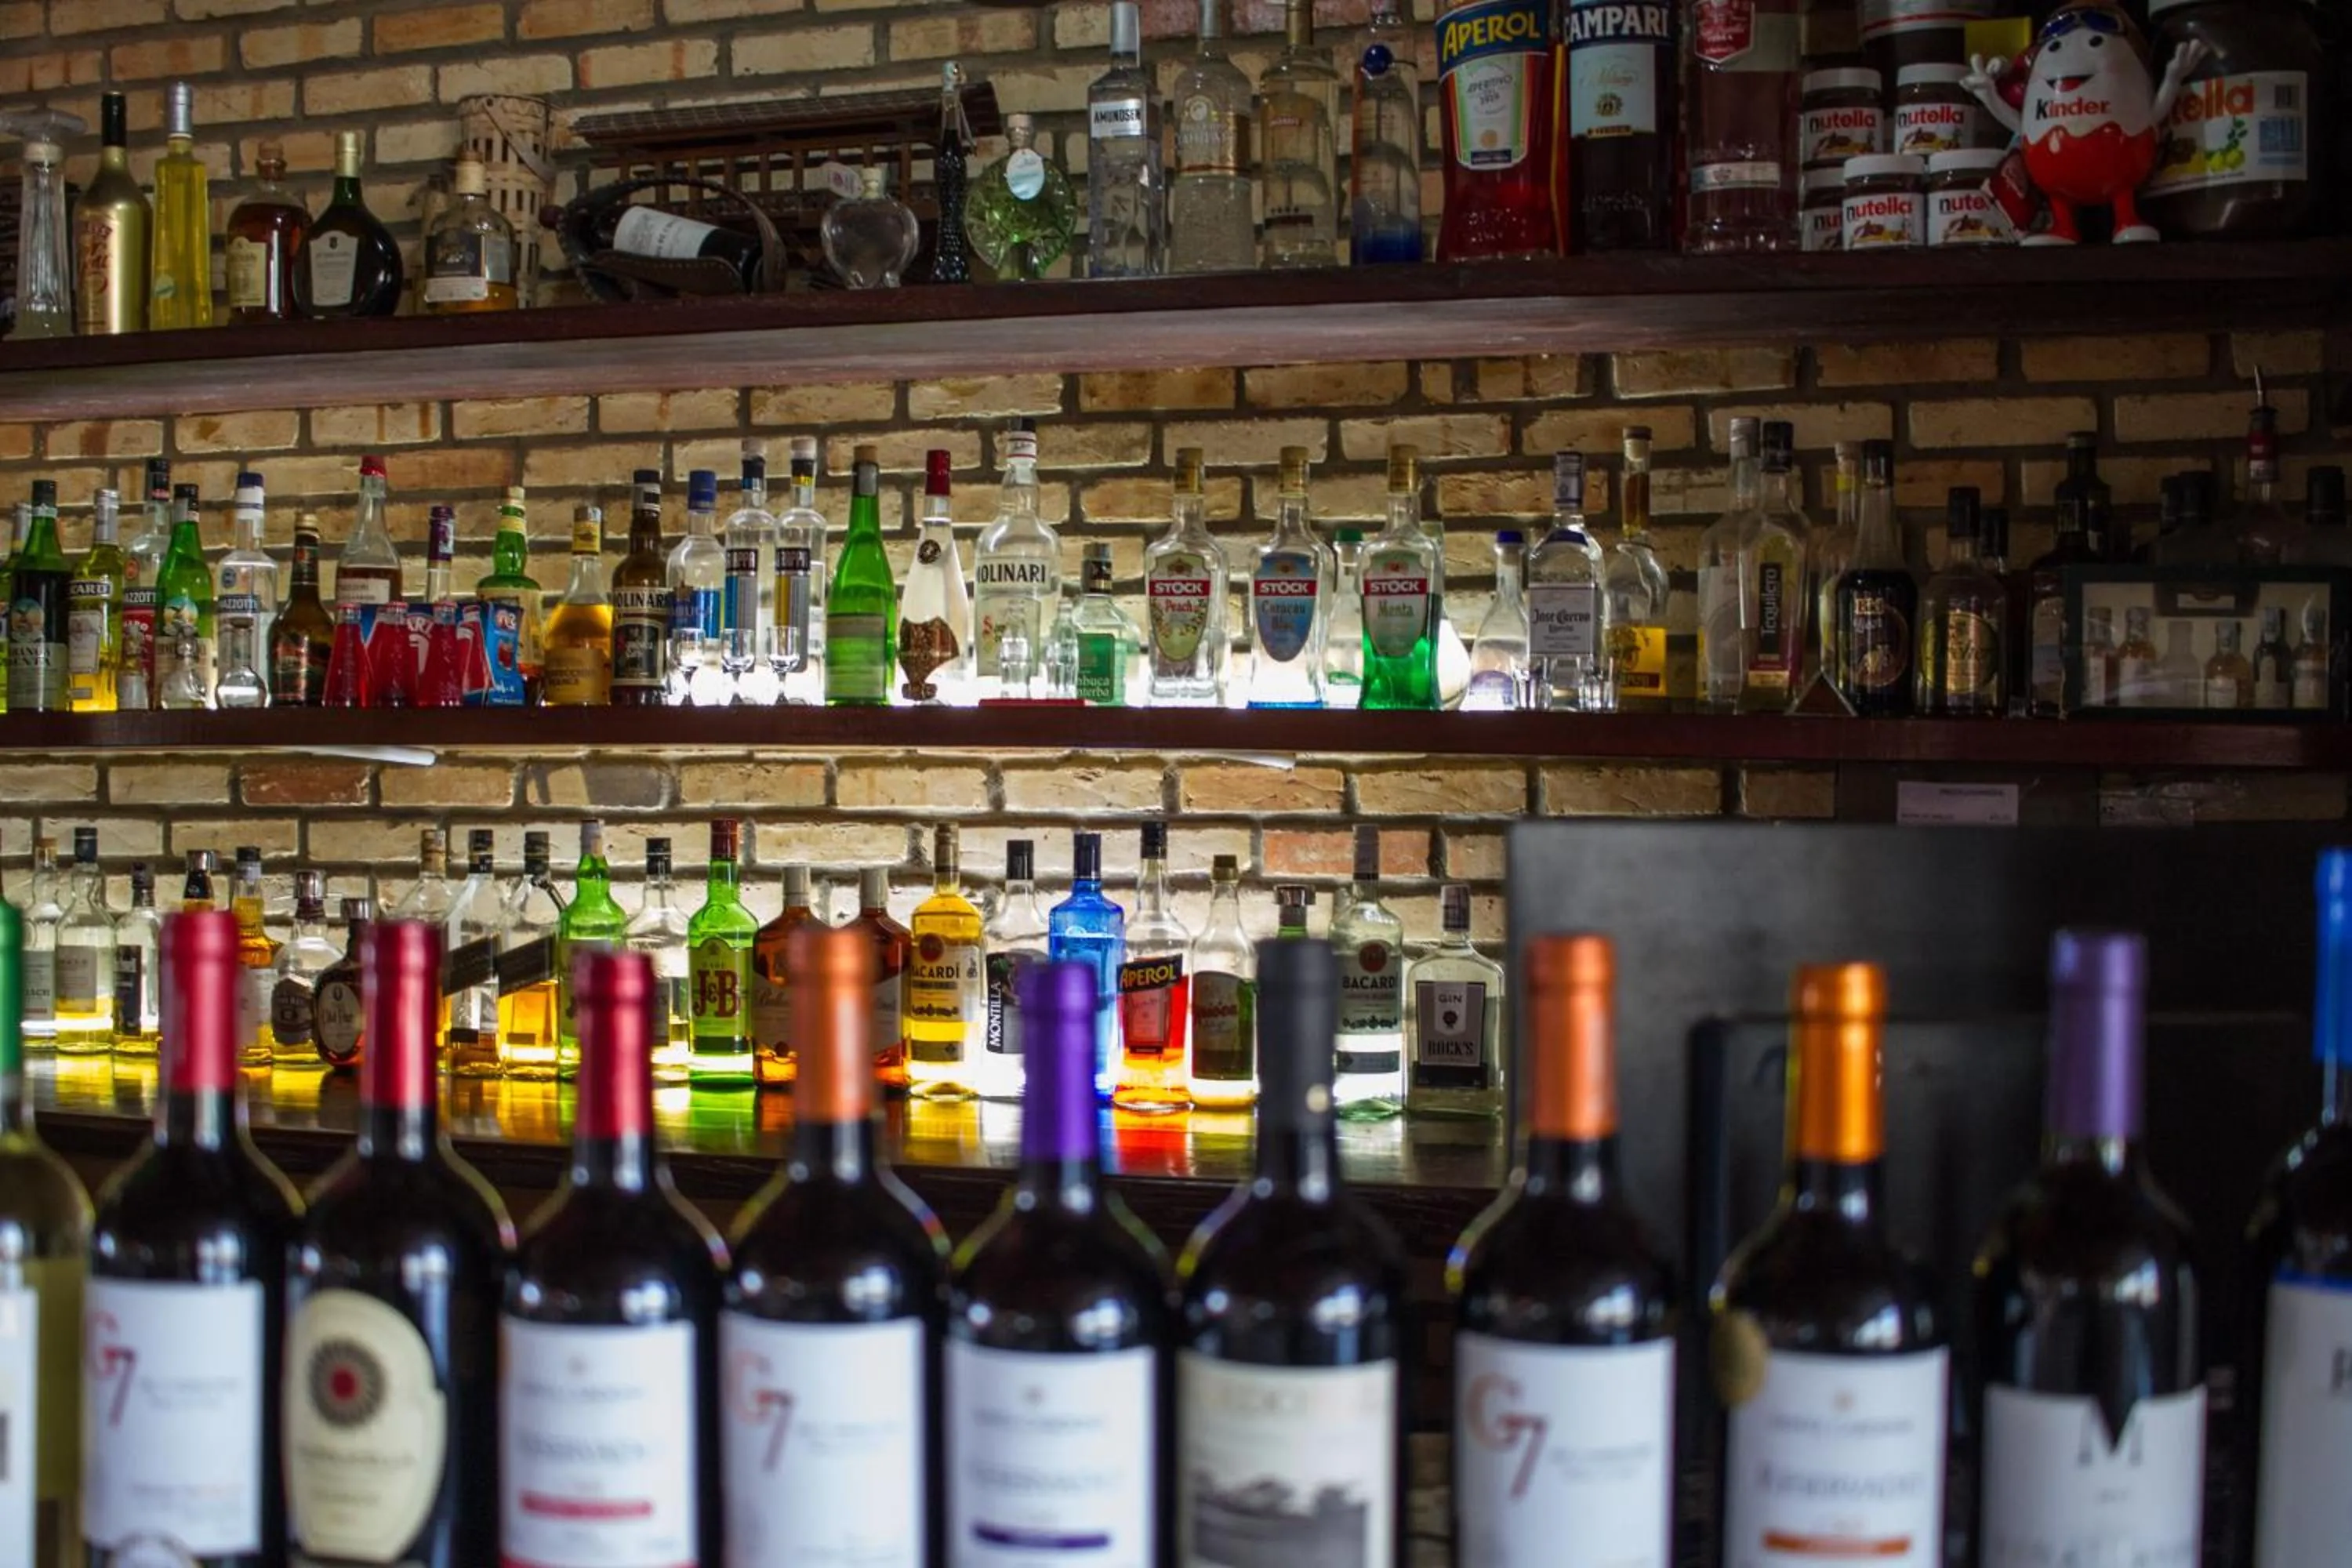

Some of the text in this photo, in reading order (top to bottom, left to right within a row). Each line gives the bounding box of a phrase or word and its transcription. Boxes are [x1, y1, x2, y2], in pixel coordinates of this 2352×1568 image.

[1443, 11, 1541, 64] APEROL
[2035, 97, 2111, 121] Kinder
[2169, 76, 2255, 125] tella
[1094, 108, 1141, 124] AMUNDSEN
[1809, 110, 1877, 133] nutella
[1898, 106, 1965, 127] nutella
[1846, 197, 1913, 222] nutella
[1939, 196, 1987, 215] nute
[1155, 581, 1203, 594] STOCK
[1260, 581, 1309, 594] STOCK
[1370, 580, 1420, 593] STOCK
[125, 592, 157, 603] AZZOTT
[615, 592, 666, 608] OLINAR
[1531, 608, 1555, 624] Jose
[1077, 675, 1110, 687] buca
[1120, 964, 1177, 989] APEROL
[693, 969, 741, 1018] J&B
[1438, 994, 1463, 1004] GIN
[990, 982, 1001, 1047] MONTILLA
[728, 1348, 794, 1474] G7
[1463, 1372, 1548, 1501] G7
